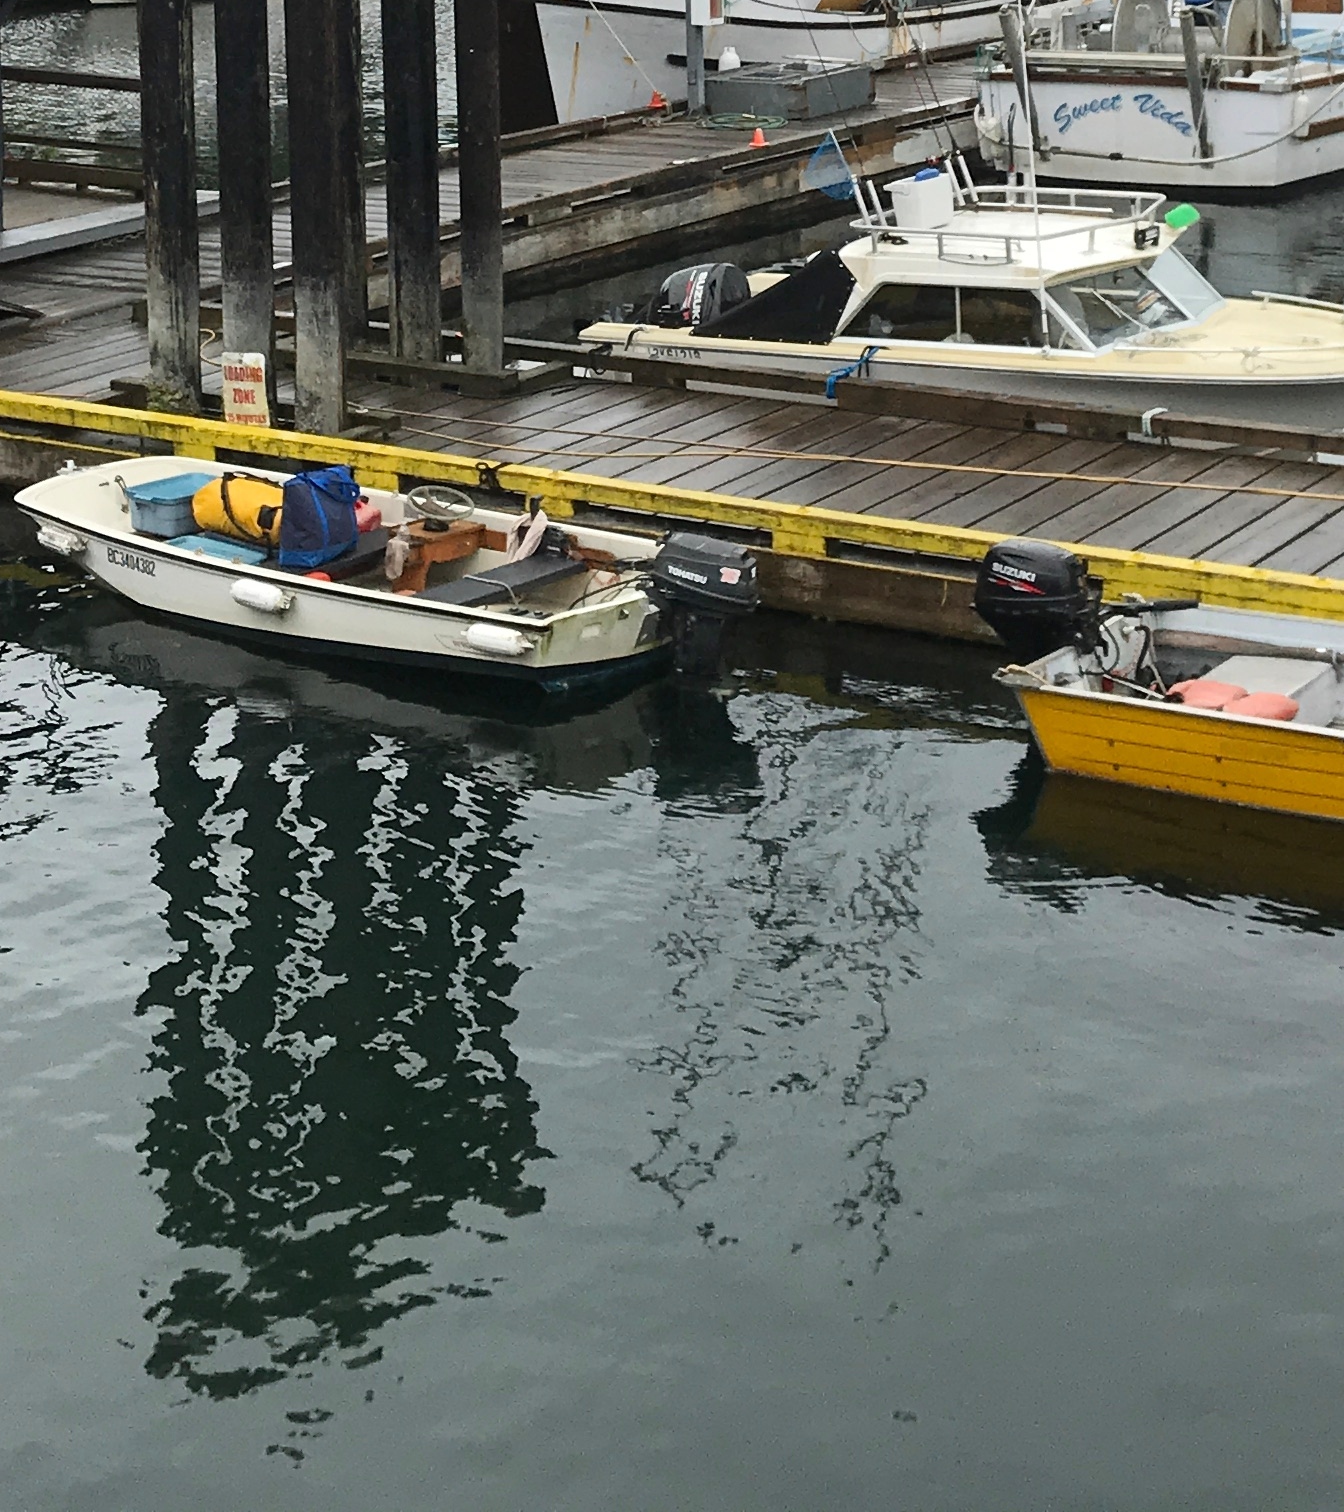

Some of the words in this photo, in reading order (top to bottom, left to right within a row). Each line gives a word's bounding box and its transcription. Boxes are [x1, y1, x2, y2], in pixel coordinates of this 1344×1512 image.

[1054, 93, 1122, 134] Sweet
[1133, 93, 1193, 137] Vida
[692, 271, 708, 325] SUZUKI
[224, 365, 263, 383] LOADING
[233, 387, 256, 405] ZONE
[992, 561, 1036, 583] SUZUKI
